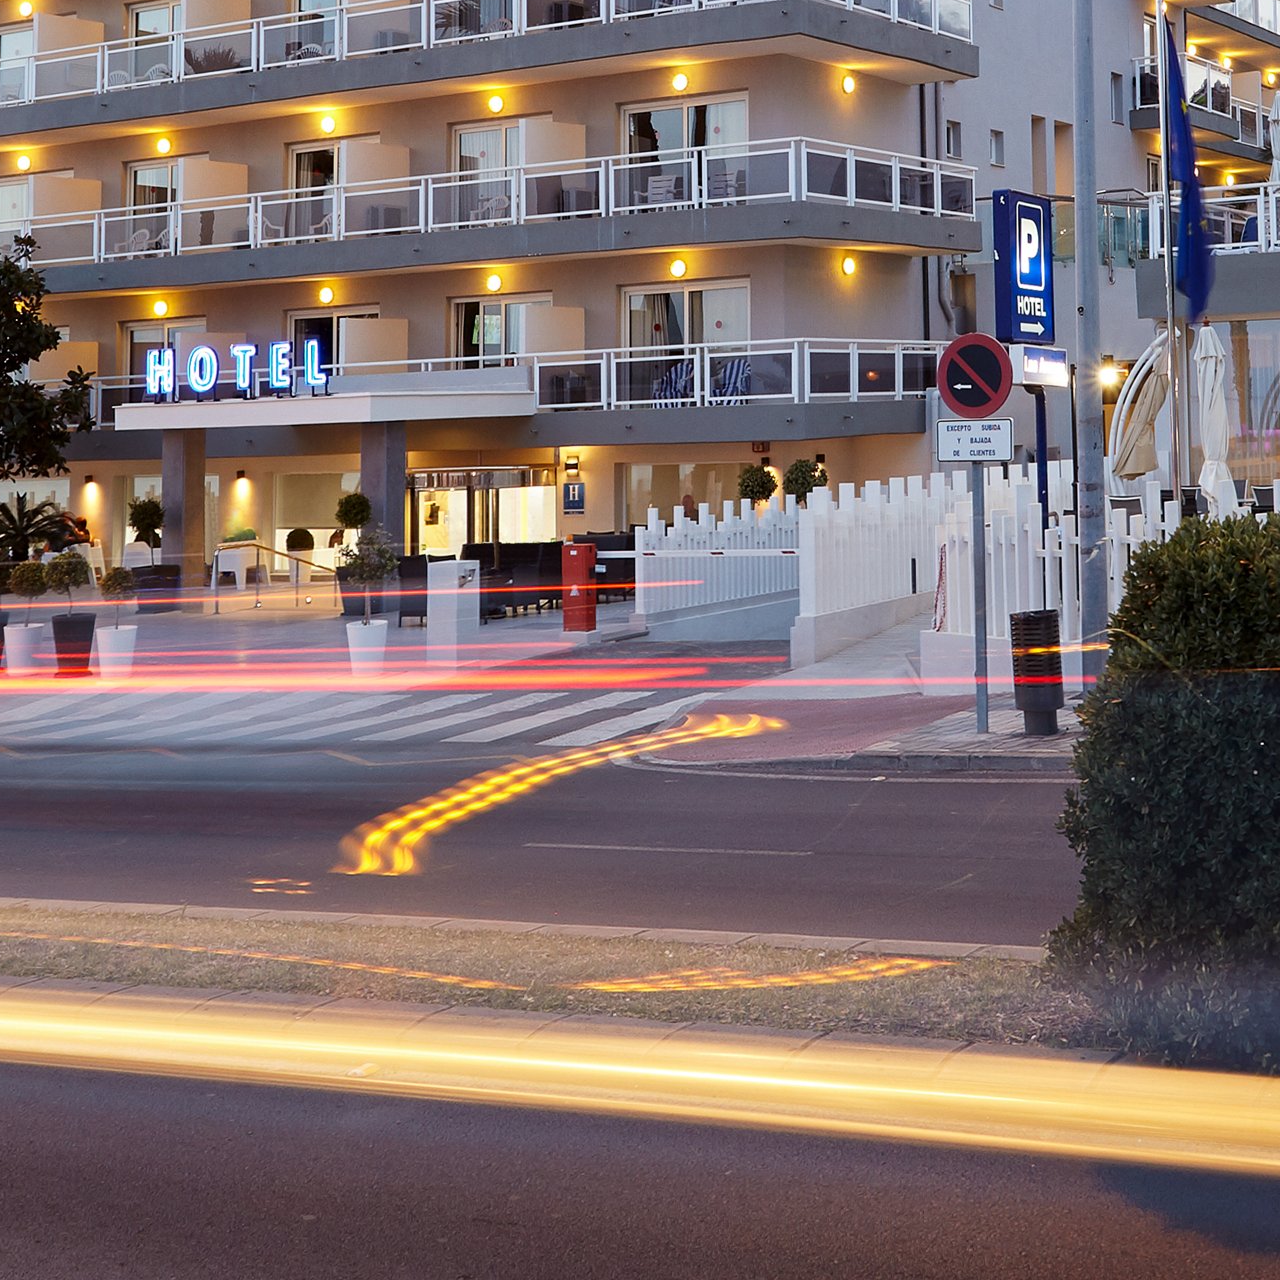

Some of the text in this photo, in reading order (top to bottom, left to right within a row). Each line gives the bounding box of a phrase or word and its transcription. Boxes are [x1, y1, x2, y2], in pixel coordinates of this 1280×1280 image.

[1021, 217, 1039, 274] P
[1017, 295, 1047, 318] HOTEL
[147, 338, 328, 394] HOTEL
[569, 485, 580, 501] H
